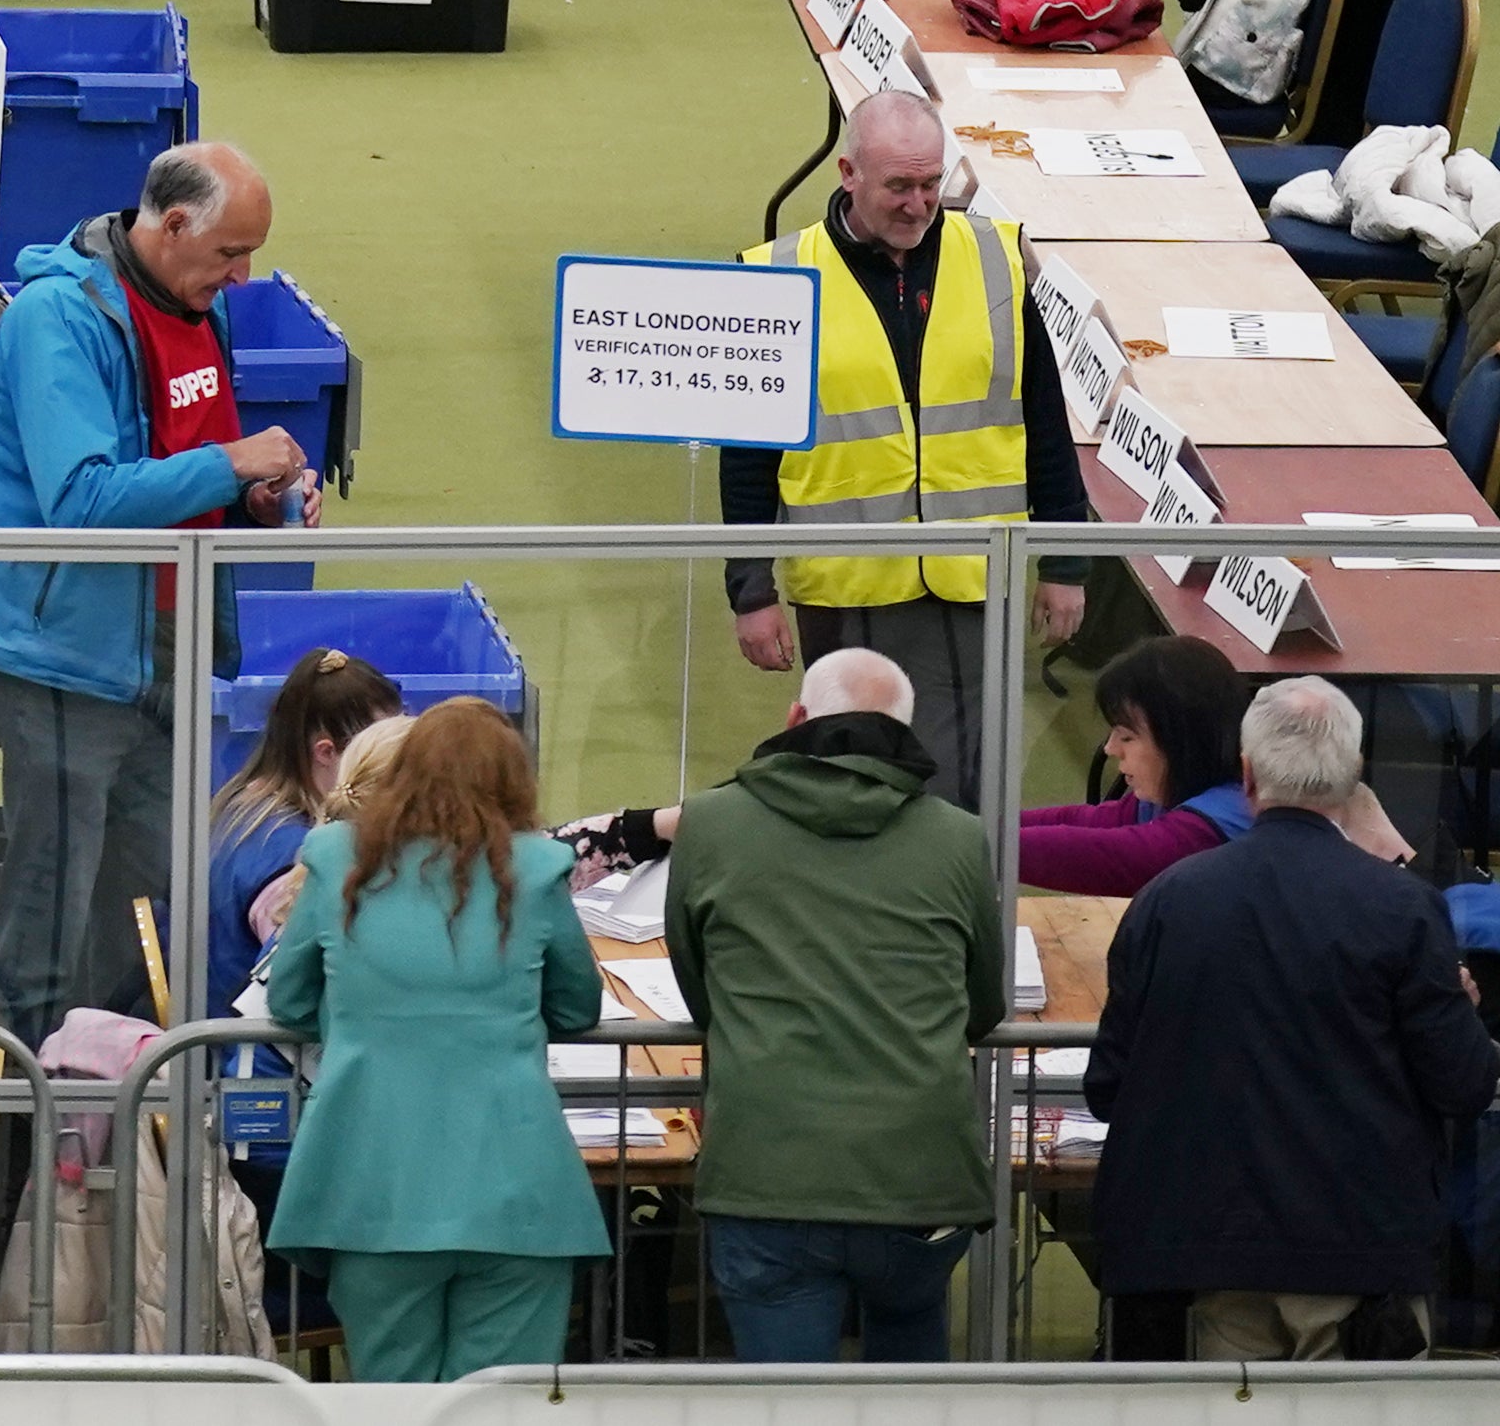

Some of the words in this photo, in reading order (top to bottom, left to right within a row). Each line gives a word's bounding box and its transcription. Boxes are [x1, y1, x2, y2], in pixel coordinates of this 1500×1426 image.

[573, 309, 628, 326] EAST
[636, 313, 800, 335] LONDONDERRY
[1229, 312, 1269, 355] WATTON
[575, 339, 691, 356] VERIFICATION
[697, 346, 719, 358] OF
[725, 347, 781, 362] BOXES
[615, 368, 646, 388] 17,
[651, 370, 683, 389] 31,
[688, 371, 720, 390] 45,
[724, 372, 756, 393] 59,
[761, 374, 785, 394] 69
[1070, 338, 1111, 411] WATTON
[1110, 404, 1173, 480] WILSON
[1220, 556, 1288, 626] WILSON
